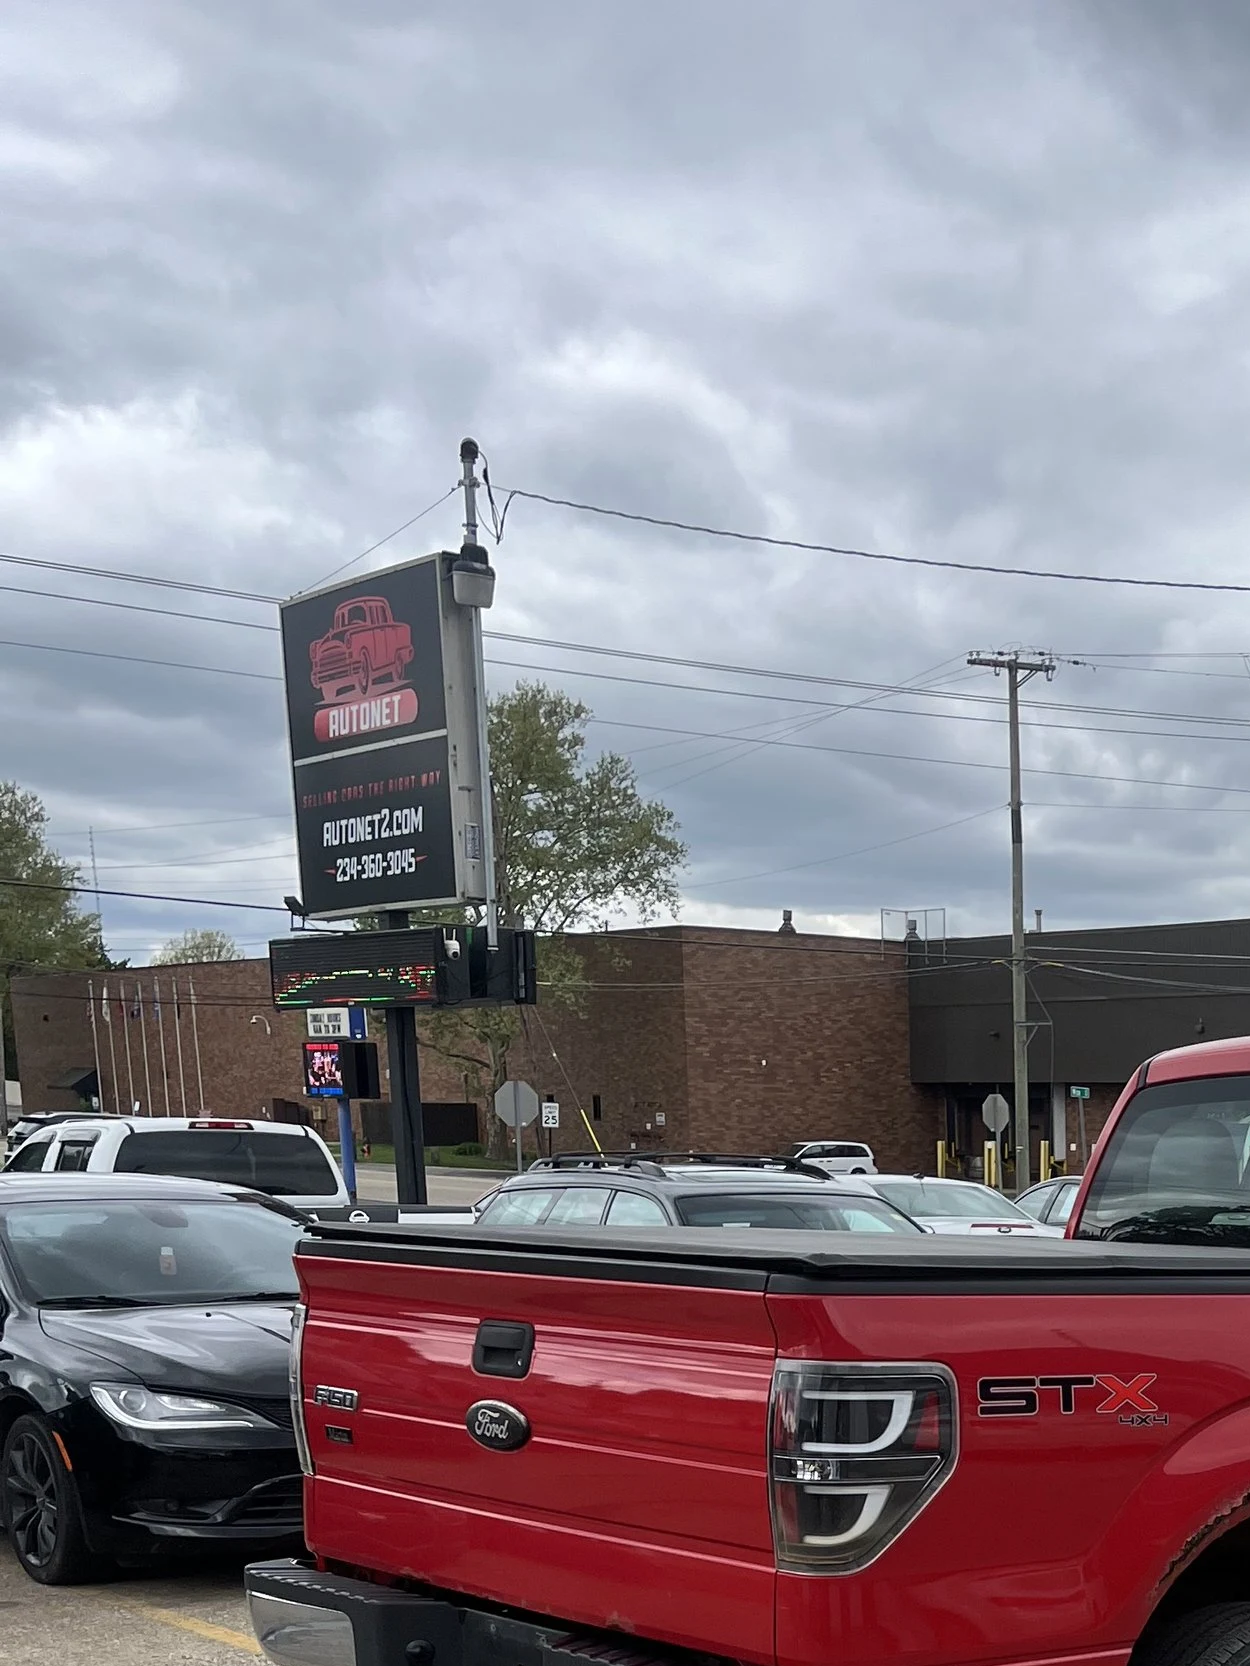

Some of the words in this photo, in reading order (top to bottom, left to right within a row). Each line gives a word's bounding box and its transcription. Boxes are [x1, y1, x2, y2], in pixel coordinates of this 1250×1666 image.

[328, 694, 401, 739] AUTONET
[302, 790, 338, 809] SELLING
[341, 784, 364, 802] CARS
[368, 781, 385, 797] THE
[388, 775, 416, 793] RIGHT
[421, 769, 441, 787] WAY
[323, 806, 423, 848] AUTONET2.COM
[336, 848, 416, 883] 234-360-3045
[544, 1115, 558, 1125] 25
[978, 1374, 1158, 1417] STX
[474, 1408, 509, 1440] Ford
